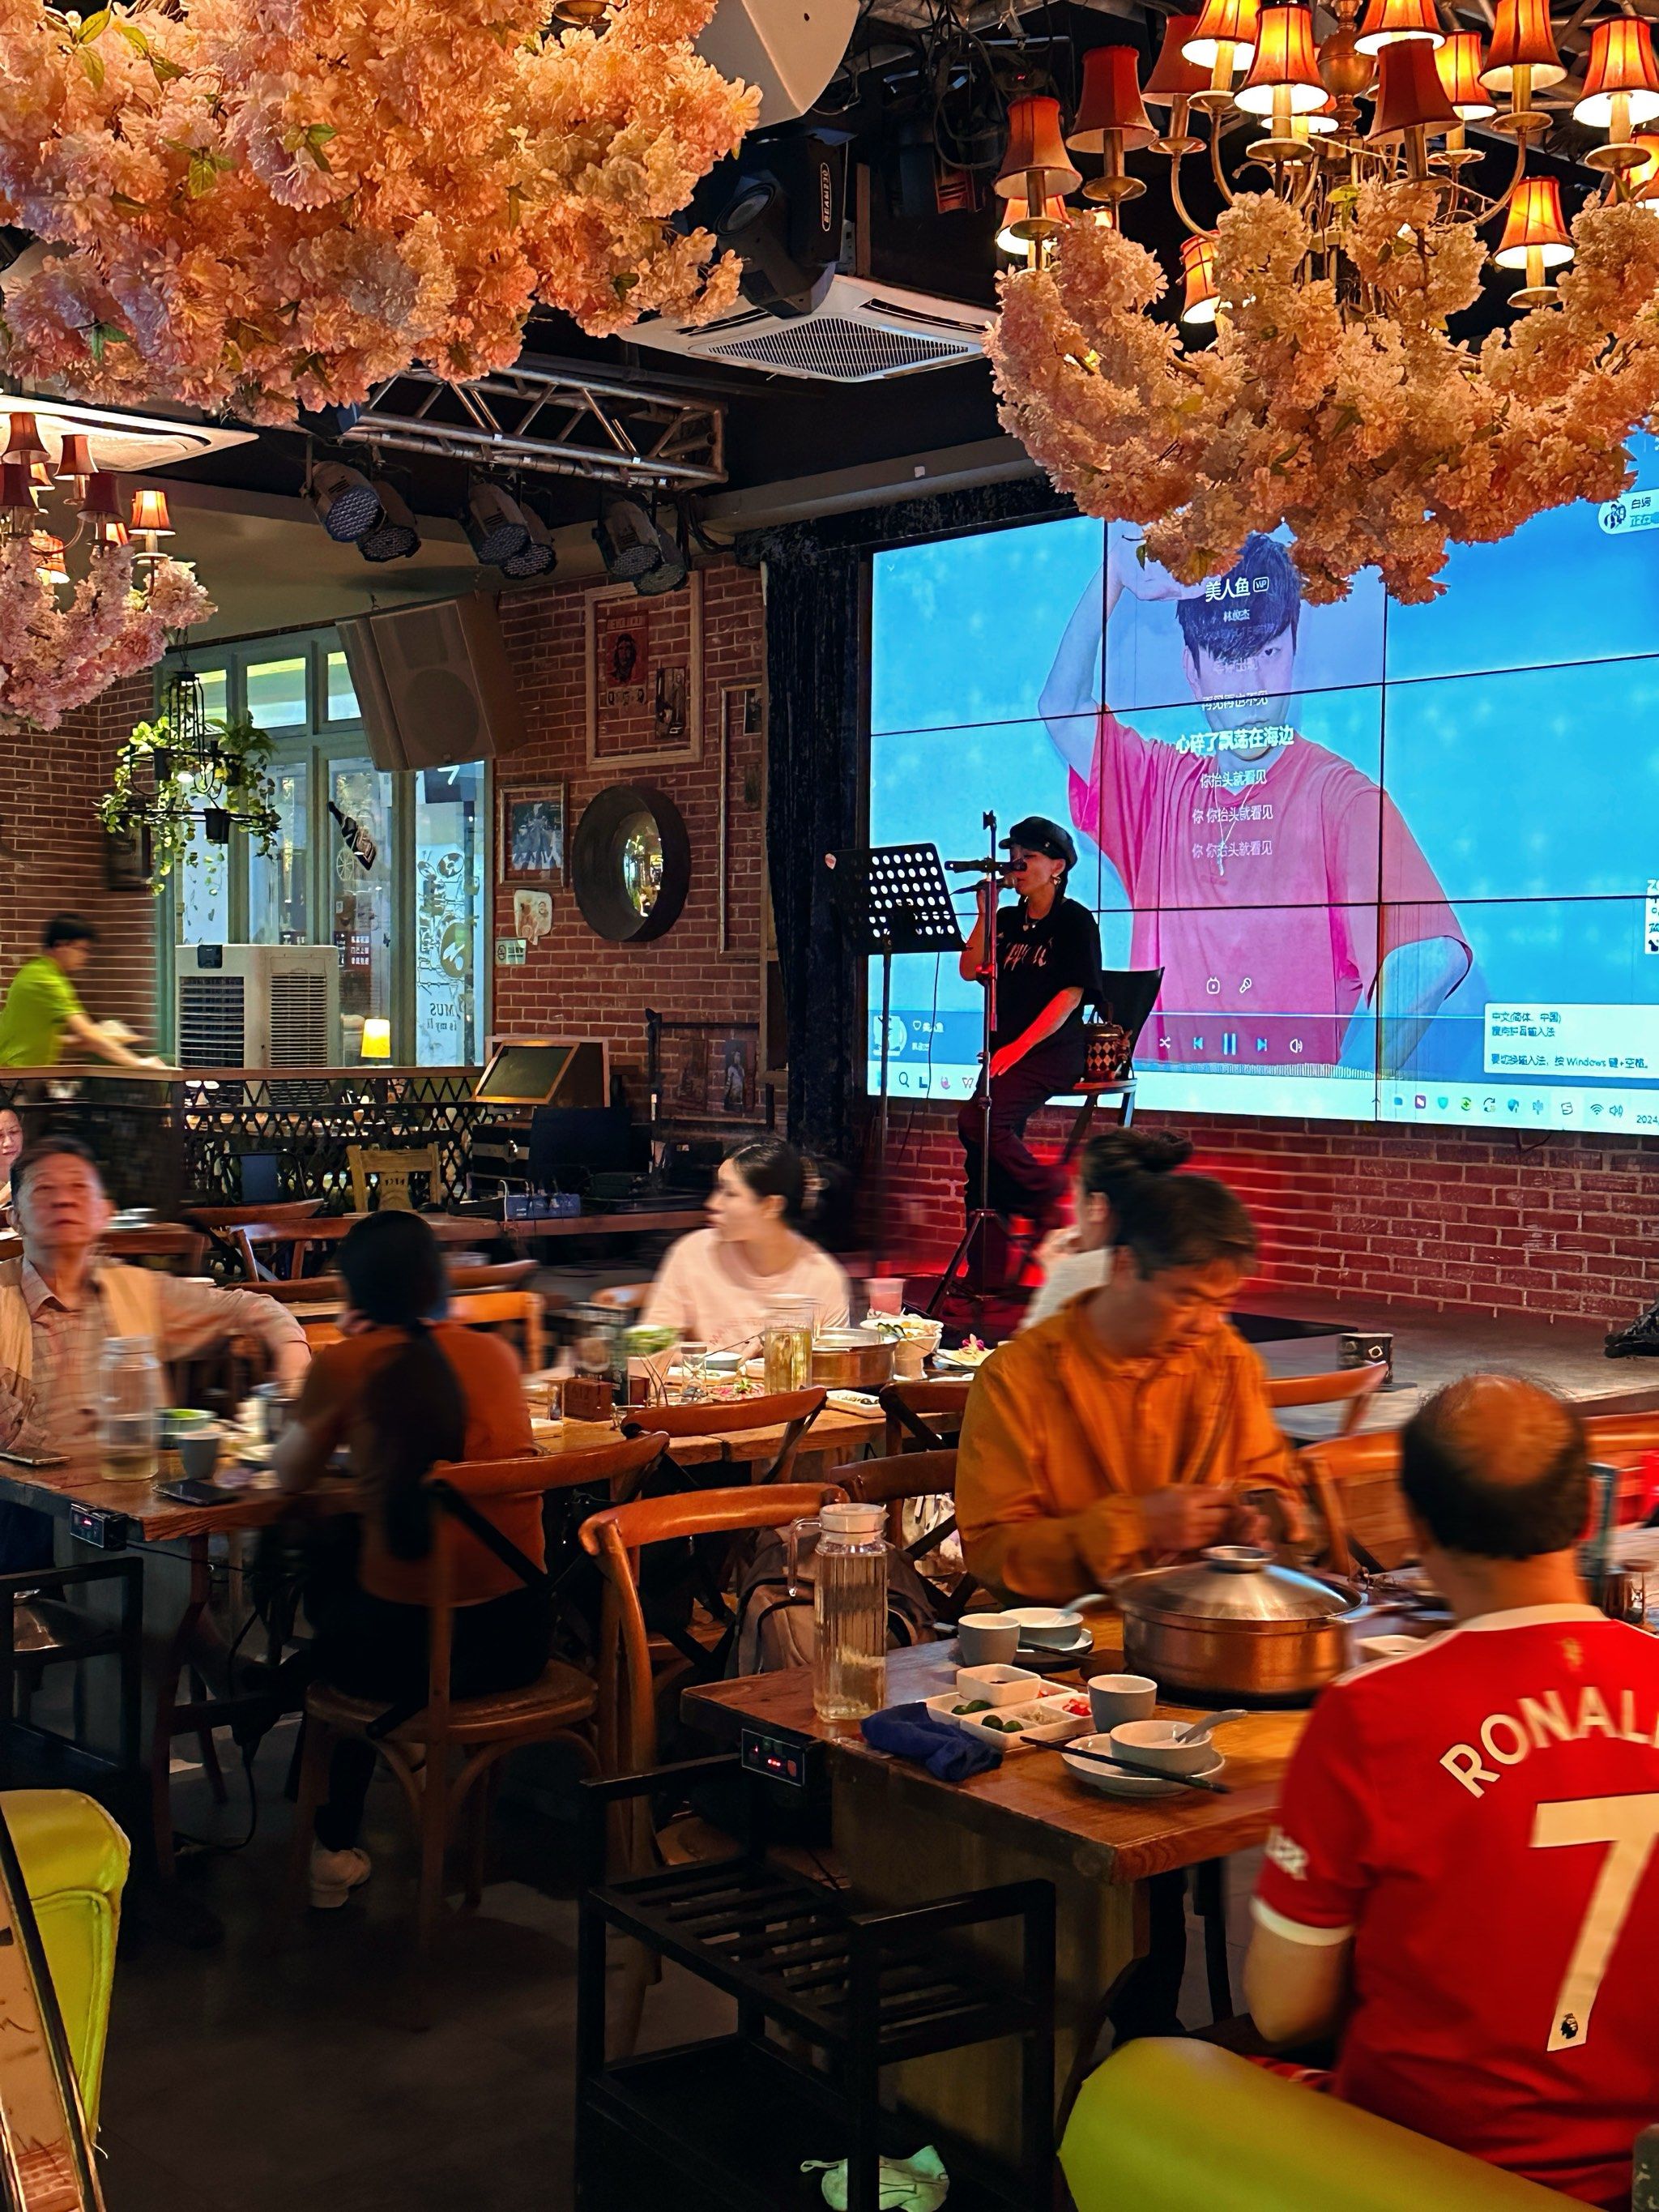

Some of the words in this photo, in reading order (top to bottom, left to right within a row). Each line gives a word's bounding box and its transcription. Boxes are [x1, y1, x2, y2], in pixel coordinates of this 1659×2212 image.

[1205, 577, 1251, 602] 美人鱼
[1175, 724, 1294, 754] 心碎了飘荡在海边
[1201, 770, 1267, 788] 你抬头就看见
[1206, 805, 1273, 823] 你抬头就看见
[1567, 1057, 1606, 1067] Windows
[1440, 1685, 1659, 1798] RONAL
[1529, 1792, 1659, 2052] 7
